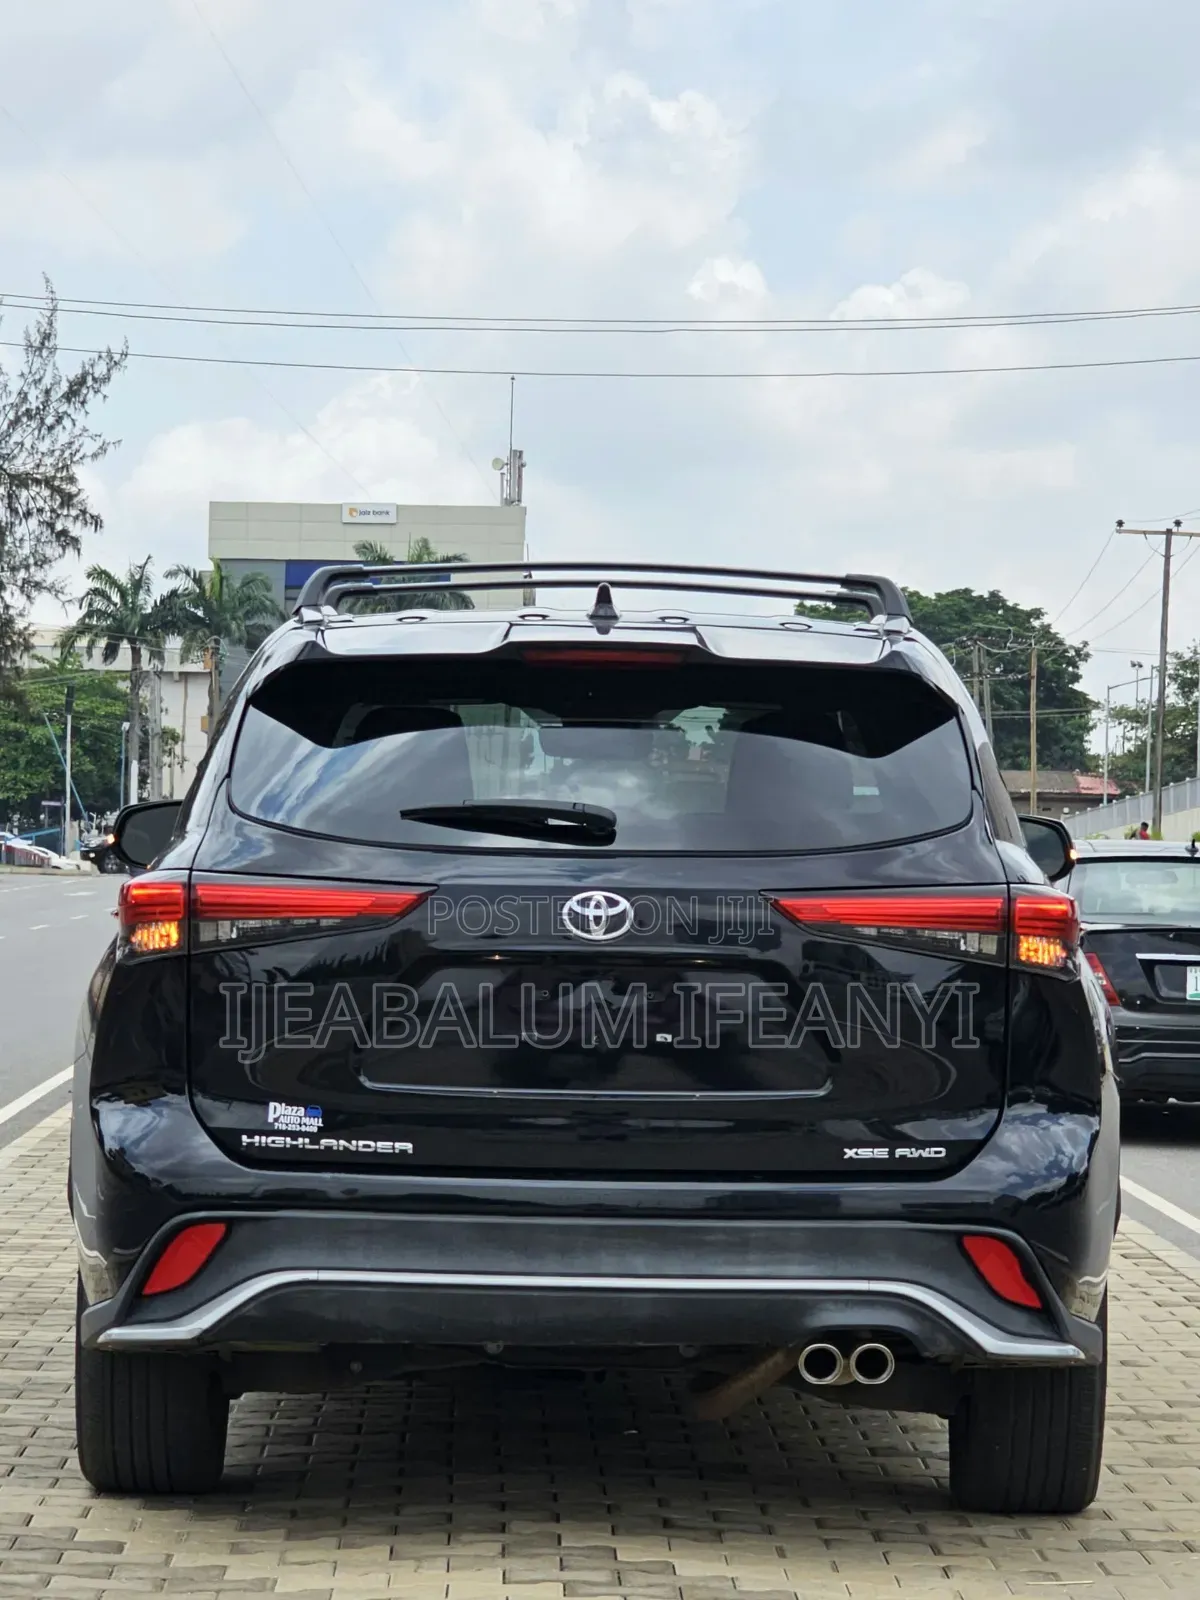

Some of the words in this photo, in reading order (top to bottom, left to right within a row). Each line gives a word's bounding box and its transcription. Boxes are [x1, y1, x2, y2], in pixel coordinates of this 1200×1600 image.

[268, 1101, 305, 1123] Plaza
[279, 1115, 300, 1125] AUTO
[301, 1117, 324, 1127] MALL
[241, 1134, 414, 1155] HIGHLANDER
[843, 1148, 890, 1159] XSE
[894, 1147, 947, 1158] AWD
